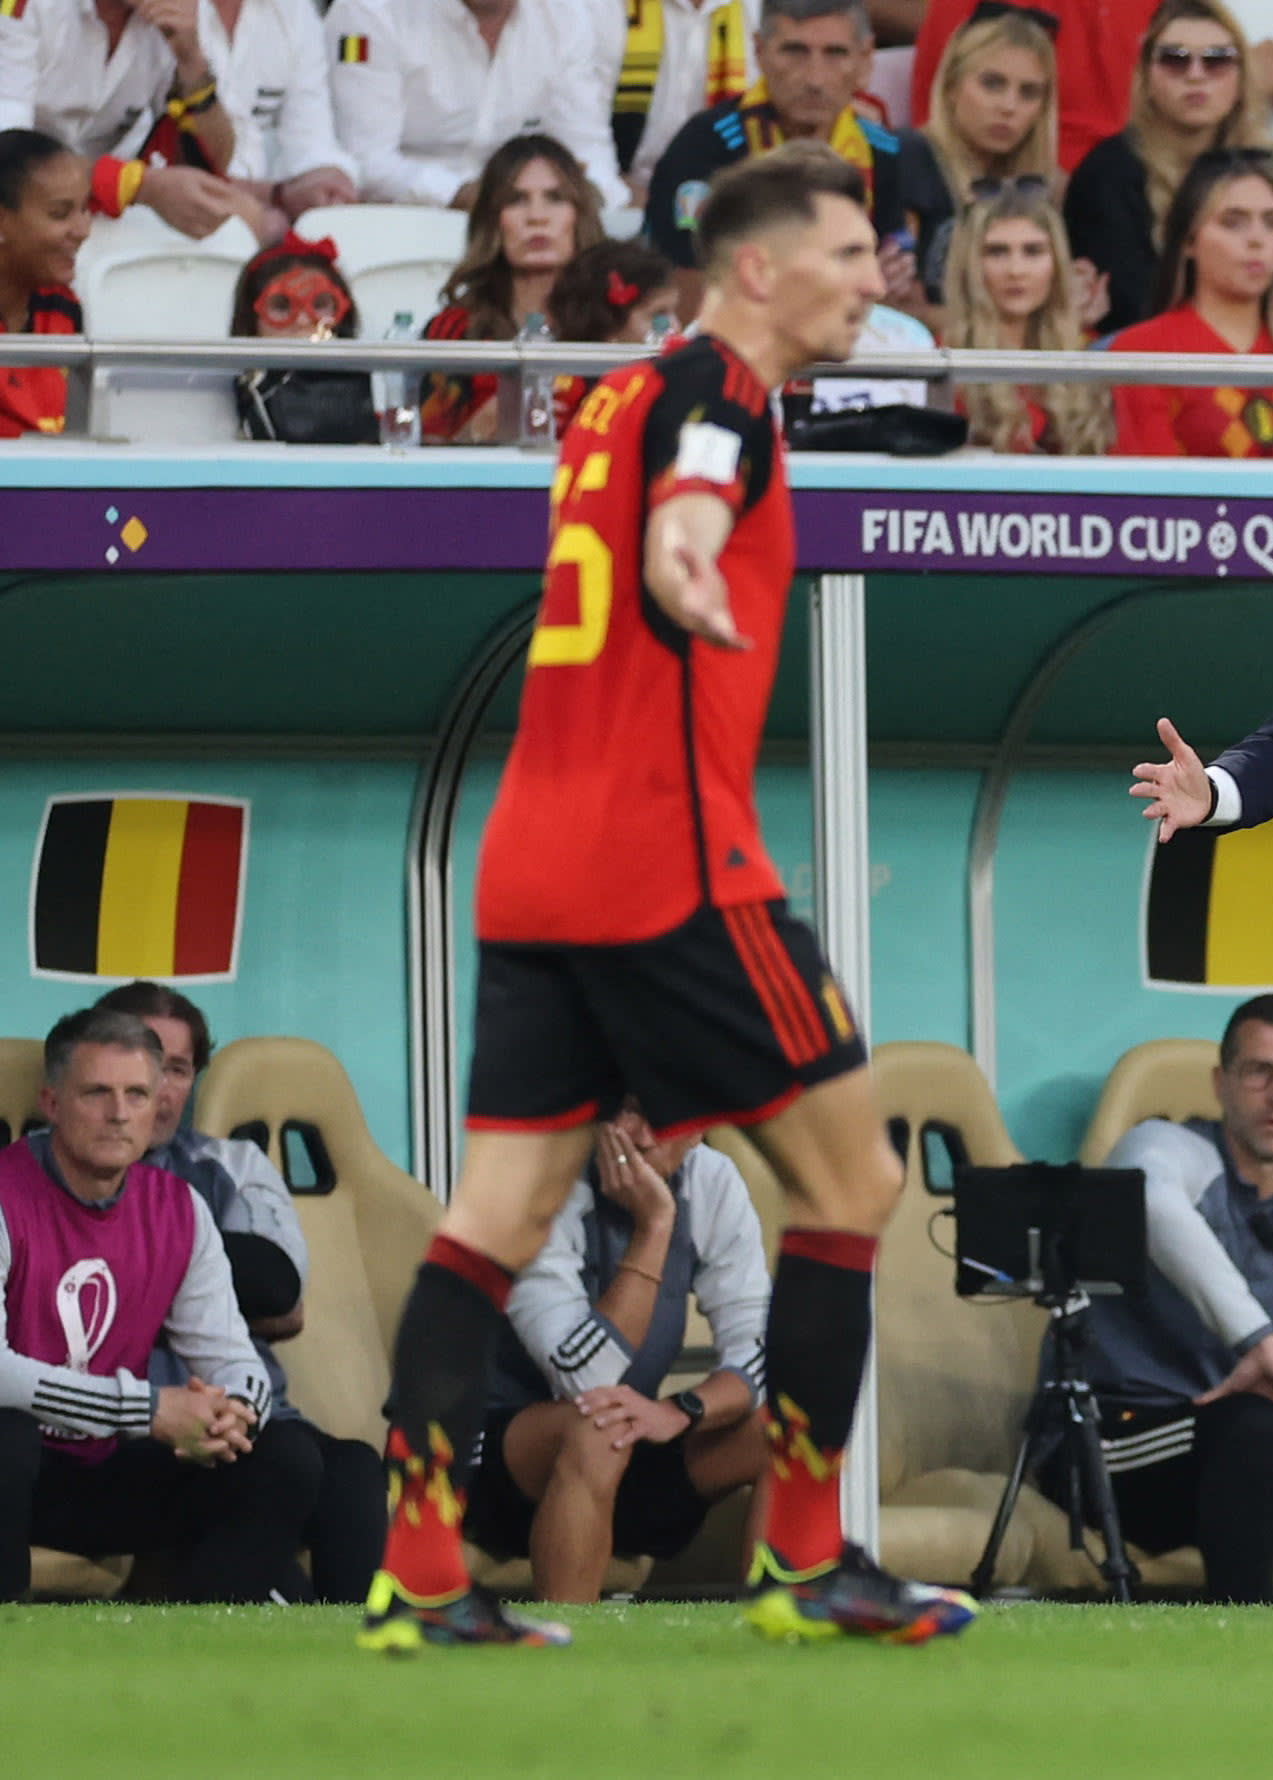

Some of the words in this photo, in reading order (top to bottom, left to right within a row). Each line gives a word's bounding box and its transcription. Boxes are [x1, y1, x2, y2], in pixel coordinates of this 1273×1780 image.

[862, 509, 954, 555] FIFA
[957, 512, 1112, 558] WORLD
[1119, 517, 1200, 563] CUP
